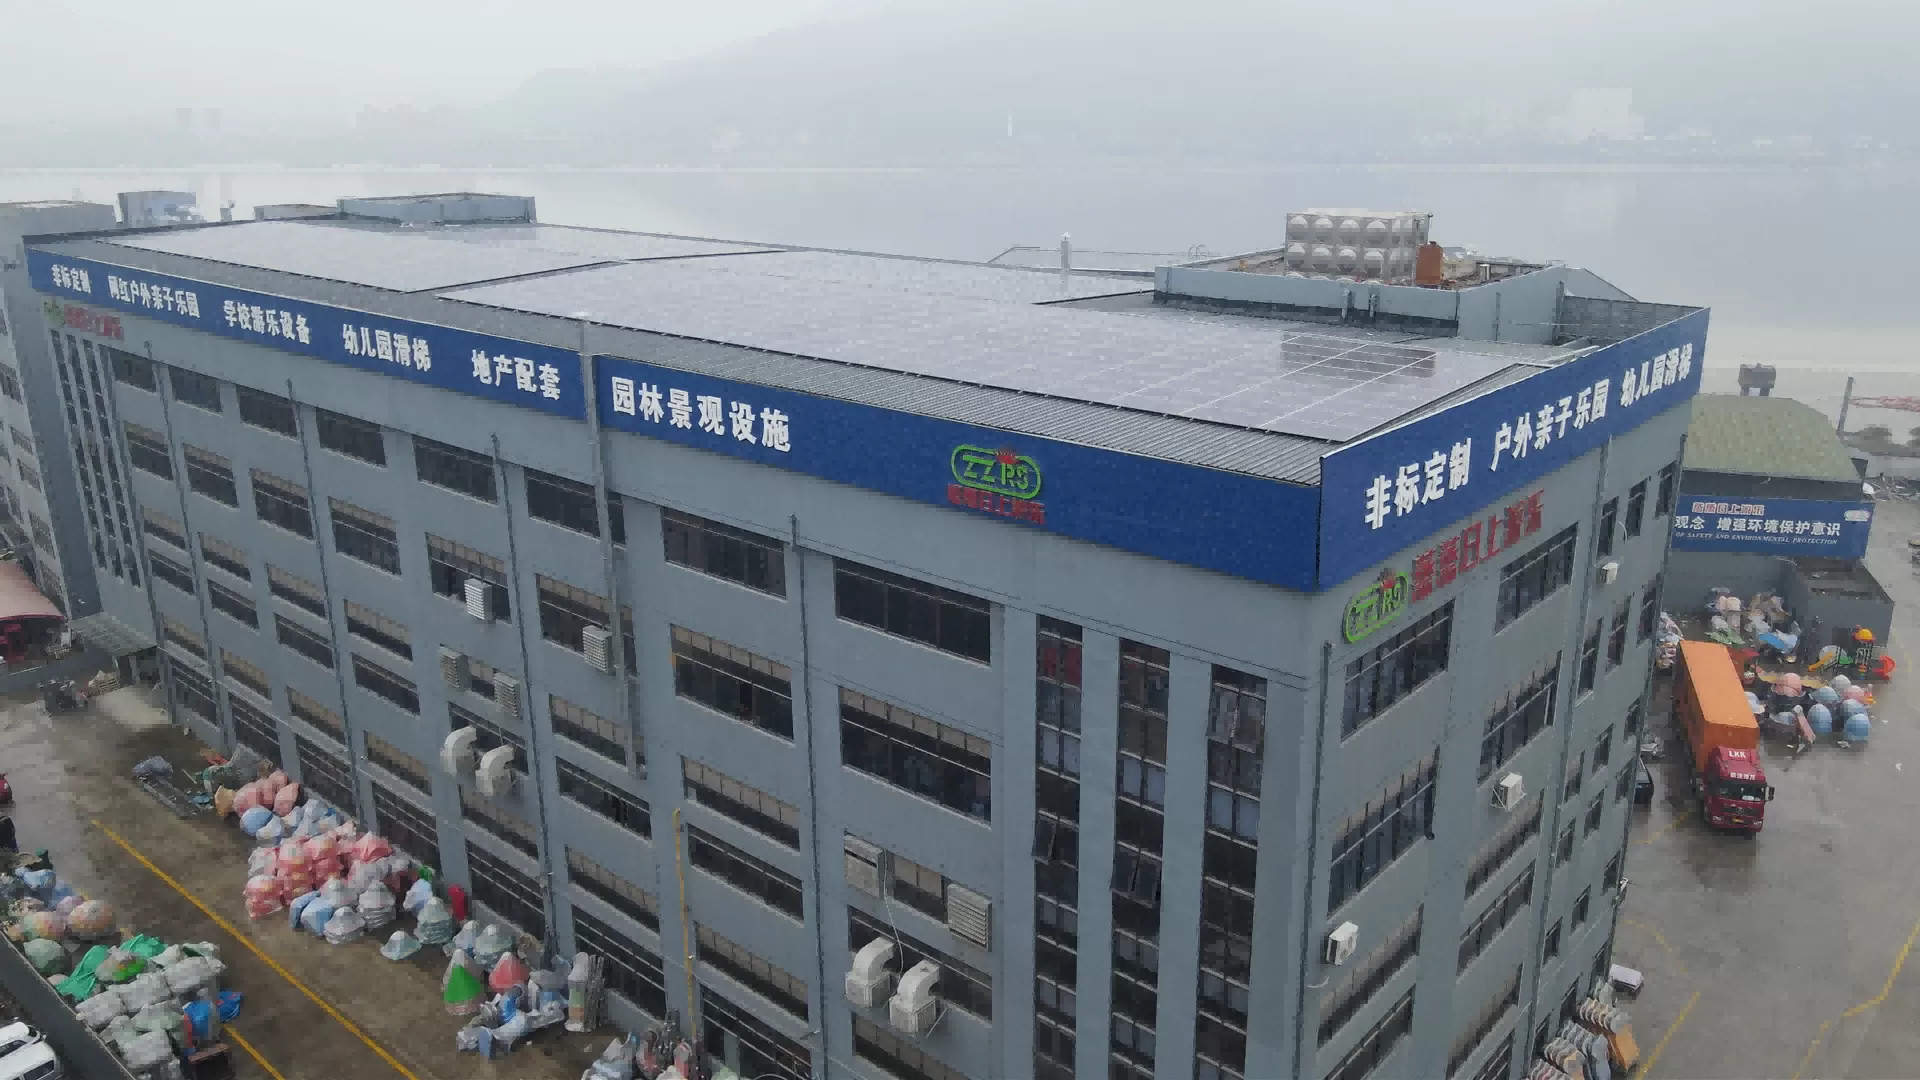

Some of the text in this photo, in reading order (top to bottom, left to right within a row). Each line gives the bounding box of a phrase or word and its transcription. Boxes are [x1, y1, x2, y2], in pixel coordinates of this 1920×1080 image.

[108, 275, 200, 318] 网红户外亲子乐园
[223, 299, 311, 345] 学校游乐设备
[342, 323, 432, 372] 幼儿园滑梯
[472, 349, 560, 400] 地产配套
[611, 376, 792, 453] 园林景观设施
[1365, 343, 1694, 530] 非标定制 户外亲子乐园 幼儿园滑梯
[1674, 516, 1841, 536] 观念 增强环境保护意识
[1731, 535, 1789, 543] ENVIRONMENTAL
[1792, 536, 1839, 545] PROTECTION
